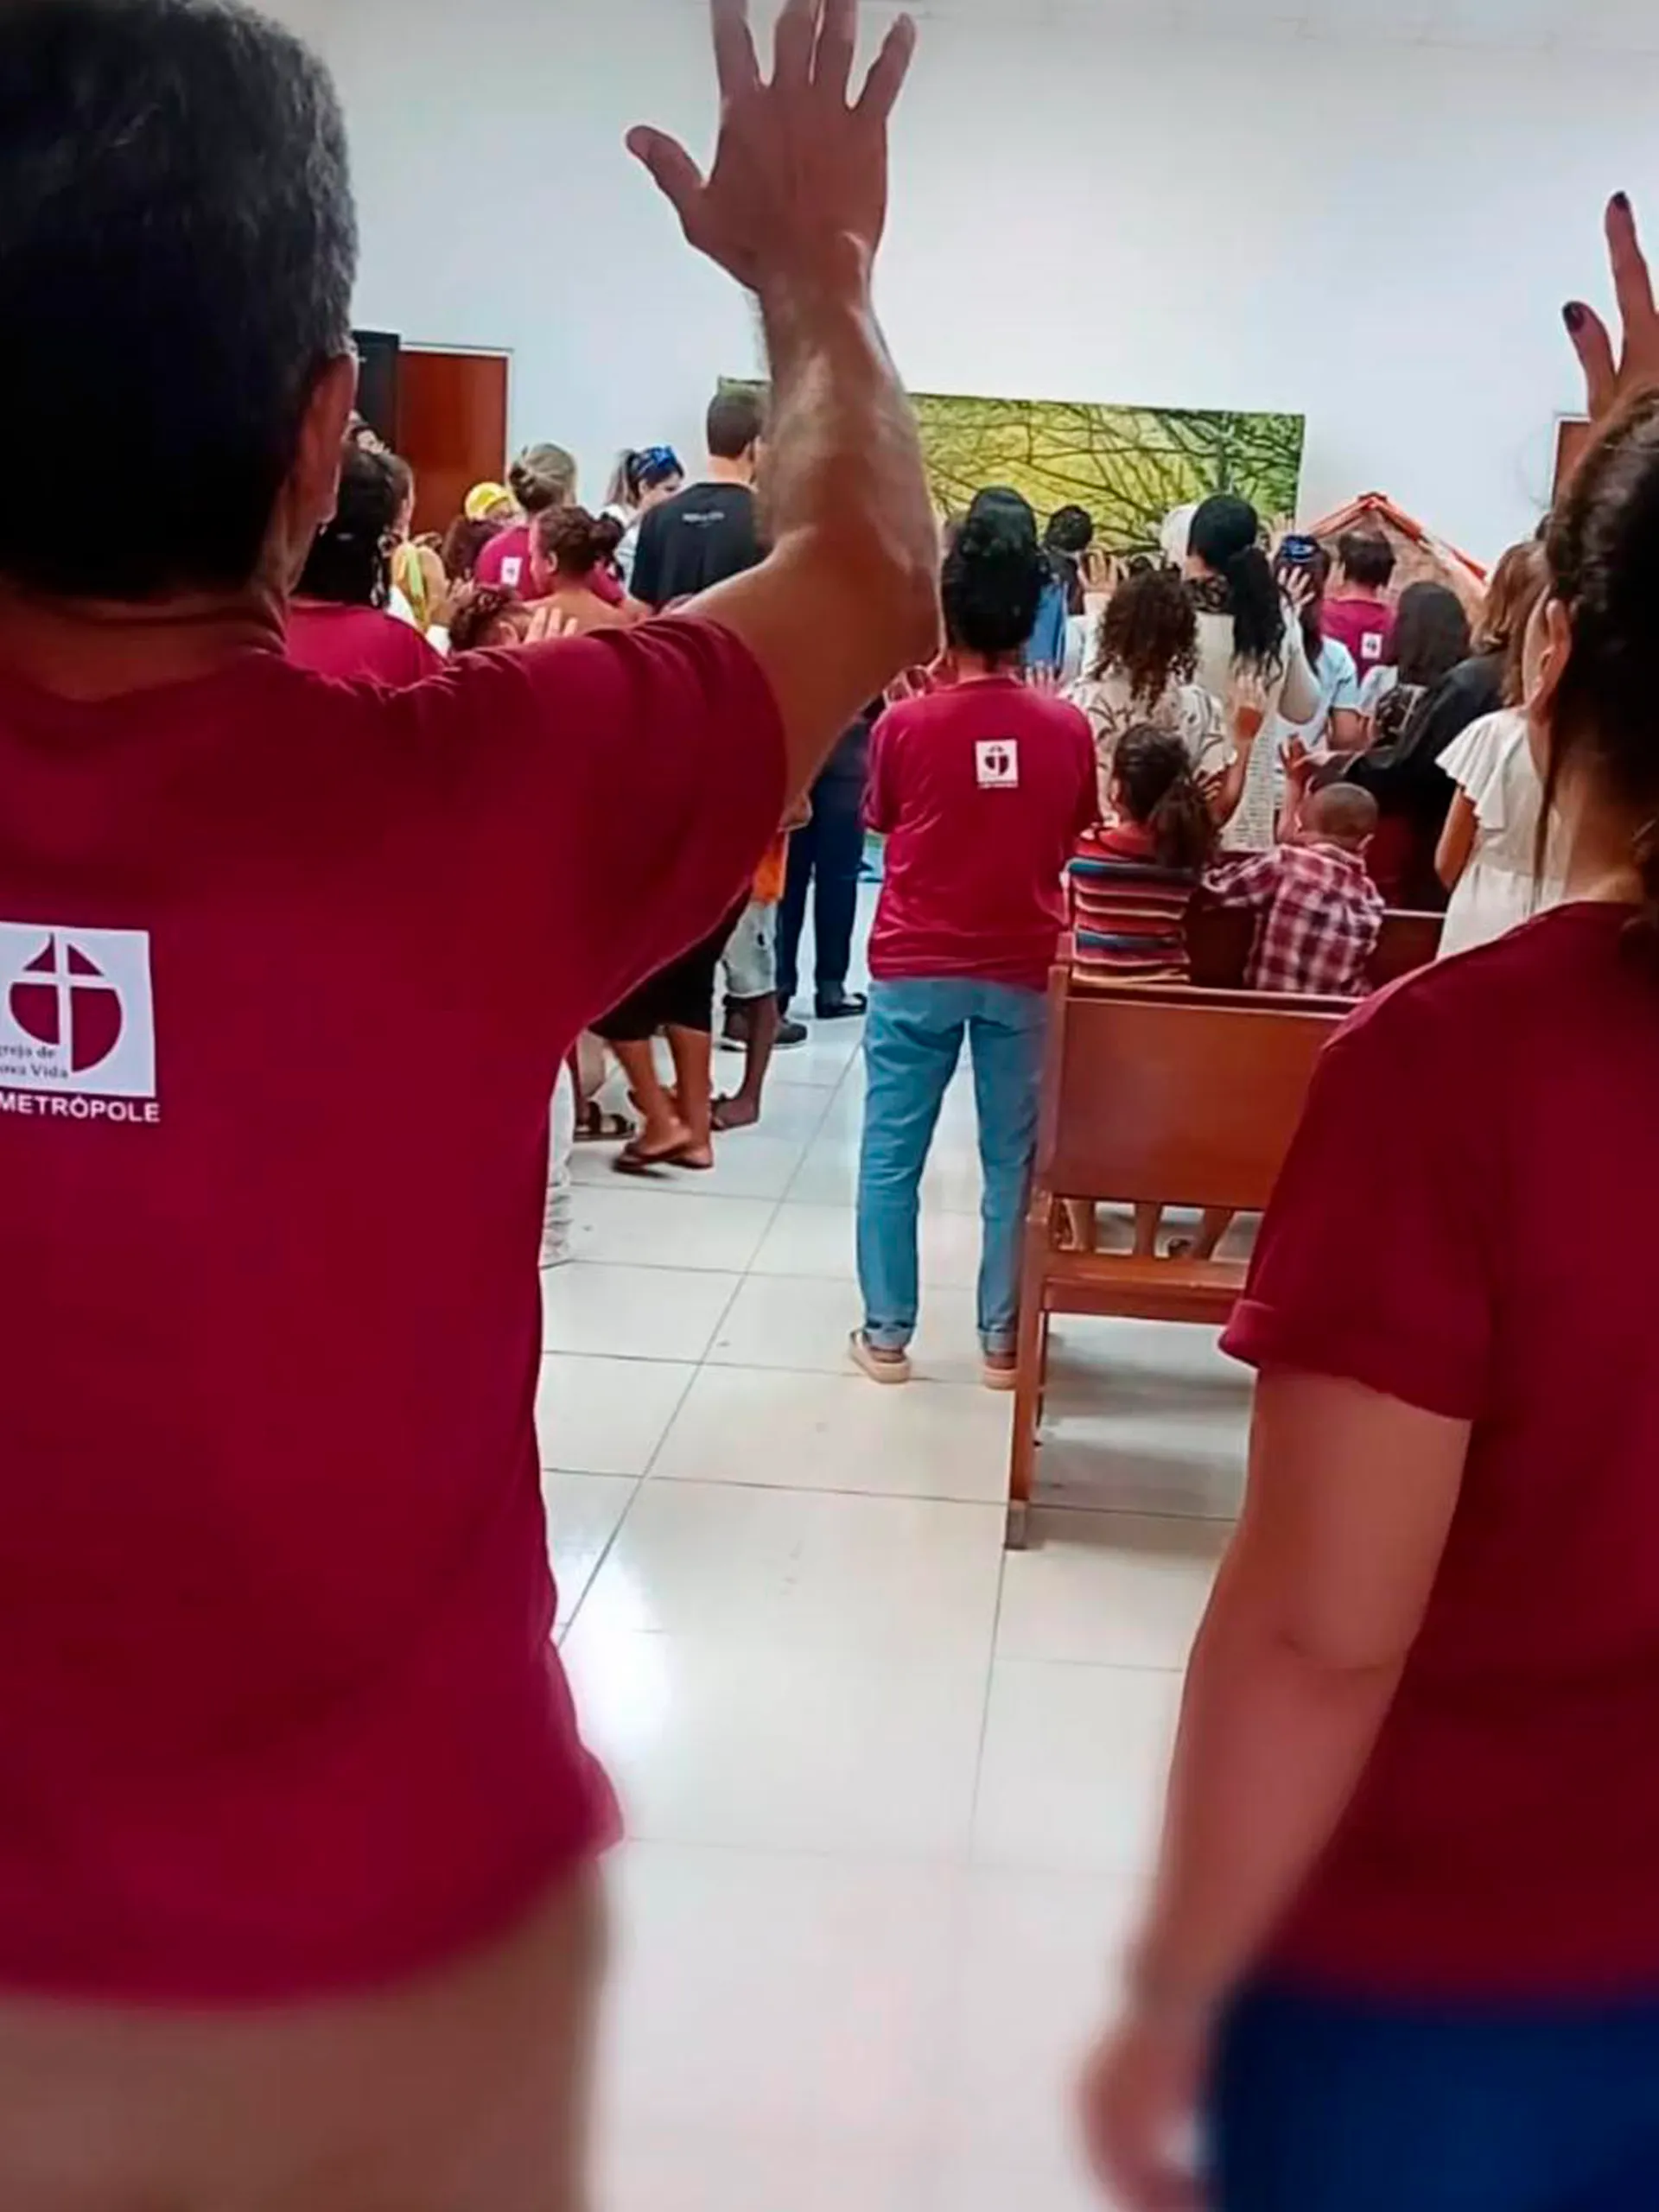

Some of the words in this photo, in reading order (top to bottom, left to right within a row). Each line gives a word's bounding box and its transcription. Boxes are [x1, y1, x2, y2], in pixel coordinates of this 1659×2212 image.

[36, 1046, 55, 1058] de
[30, 1063, 68, 1079] Vida
[0, 1091, 161, 1122] METRÓPOLE
